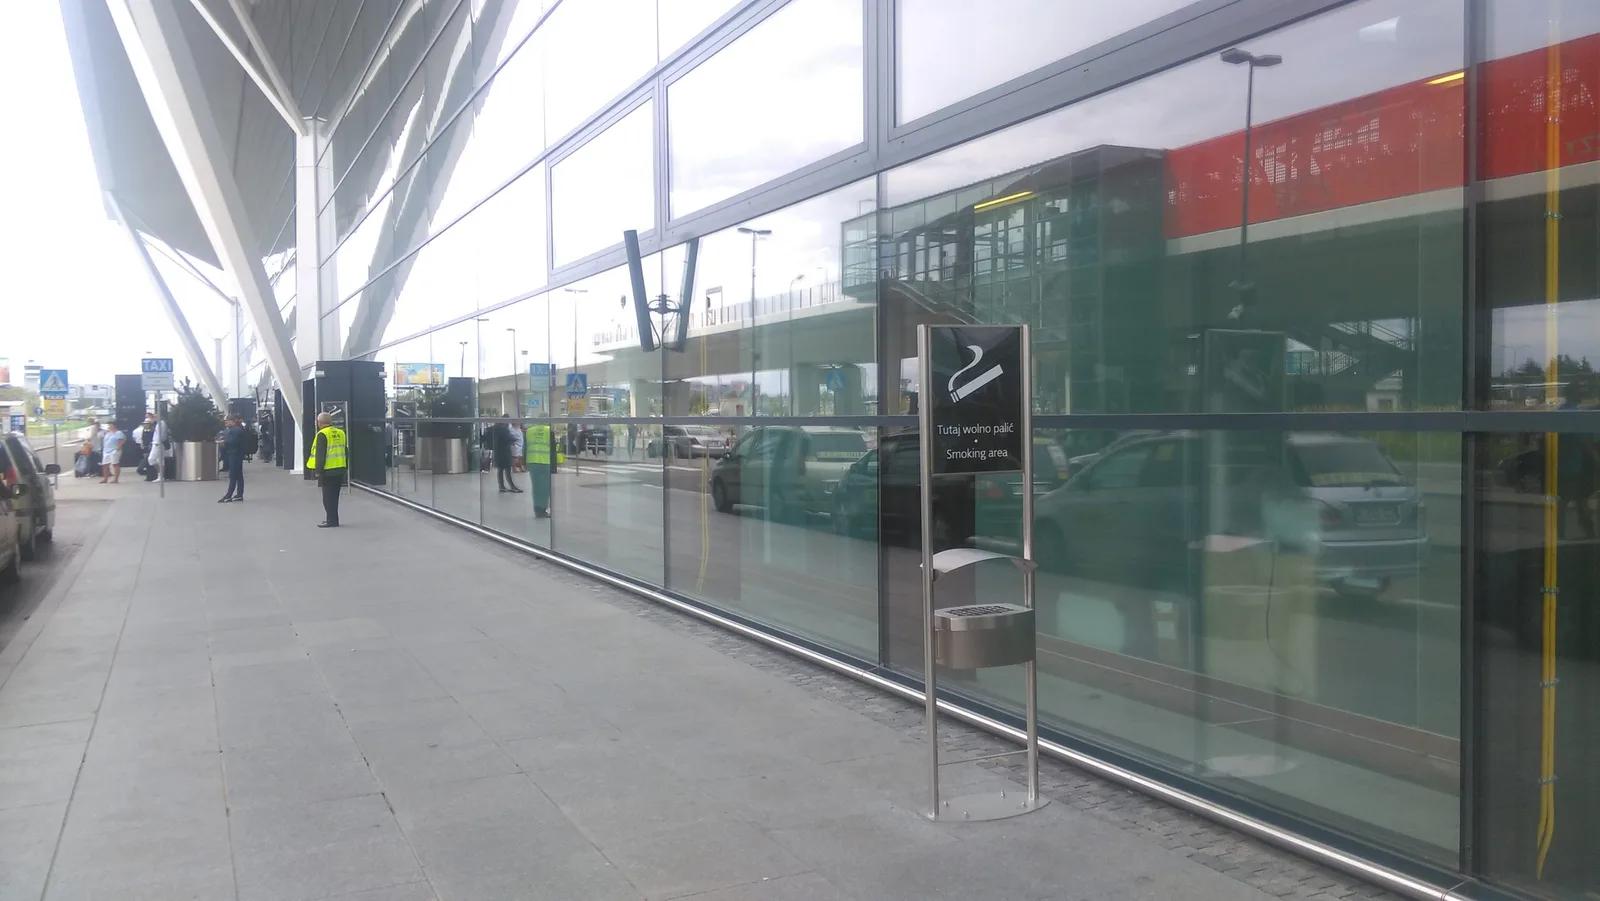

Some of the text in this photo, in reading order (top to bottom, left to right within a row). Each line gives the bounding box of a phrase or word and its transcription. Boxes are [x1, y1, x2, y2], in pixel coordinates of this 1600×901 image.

[143, 360, 172, 371] TAXI
[937, 422, 1014, 437] Tutaj wolno palić
[946, 448, 1008, 460] Smoking area
